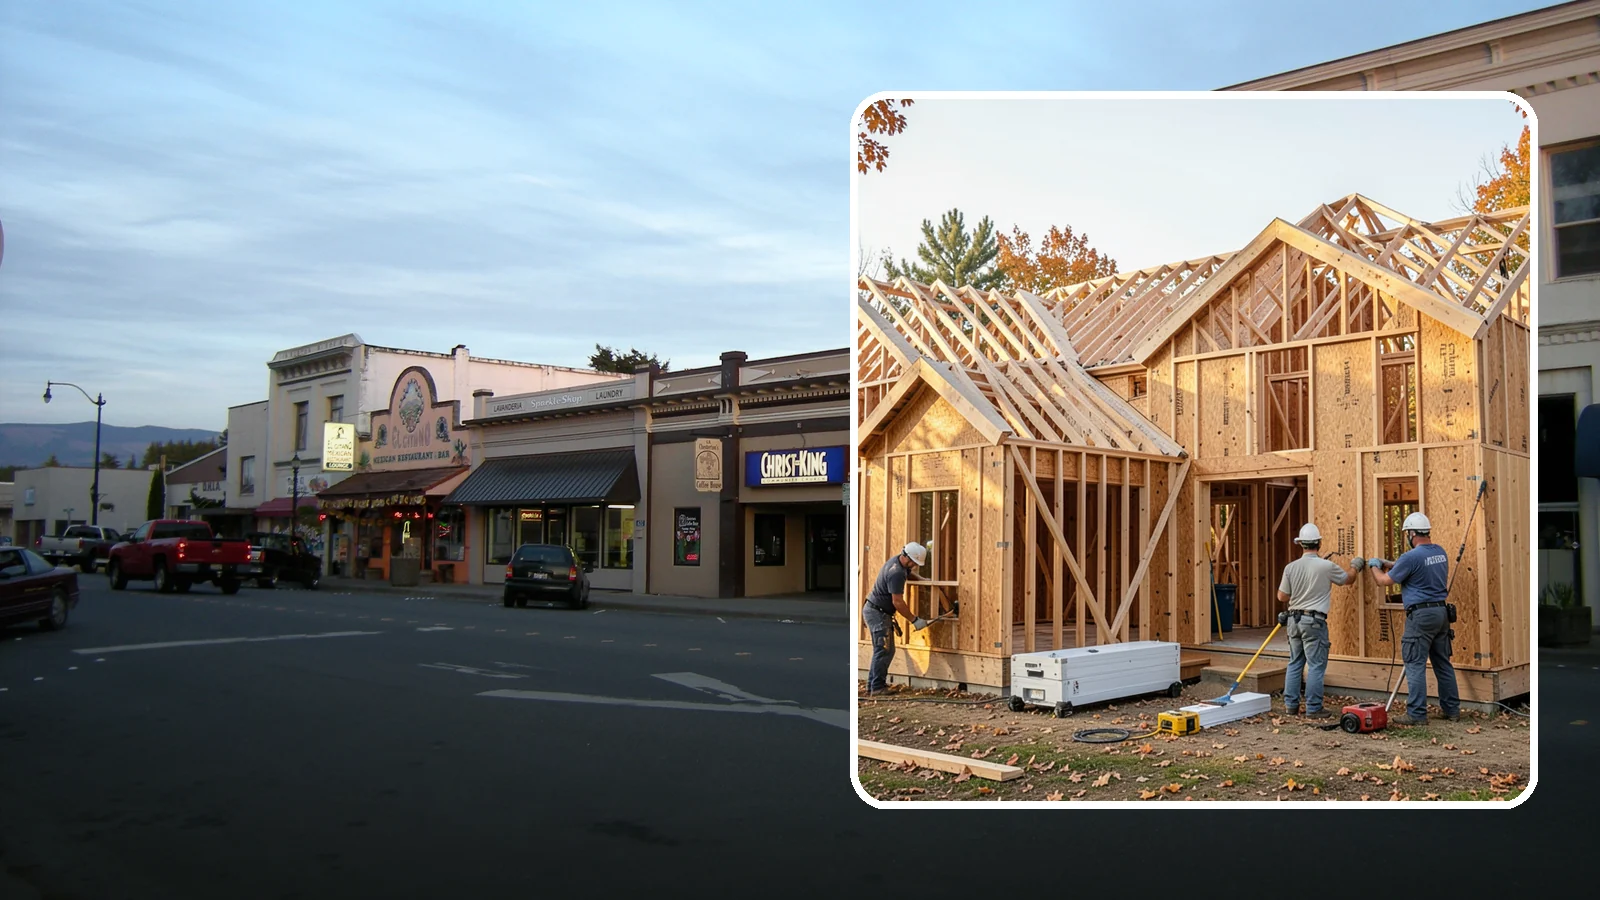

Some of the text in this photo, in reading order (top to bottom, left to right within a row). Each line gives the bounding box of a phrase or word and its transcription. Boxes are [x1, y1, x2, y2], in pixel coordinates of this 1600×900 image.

[595, 389, 623, 400] LAUNDRY
[493, 402, 522, 412] LAVANDERIA
[531, 395, 582, 408] Sparkle Shop
[373, 455, 396, 464] MEXICAN
[397, 451, 433, 462] RESTAURANT
[438, 450, 450, 459] BAR
[761, 450, 827, 478] CHRIST KING
